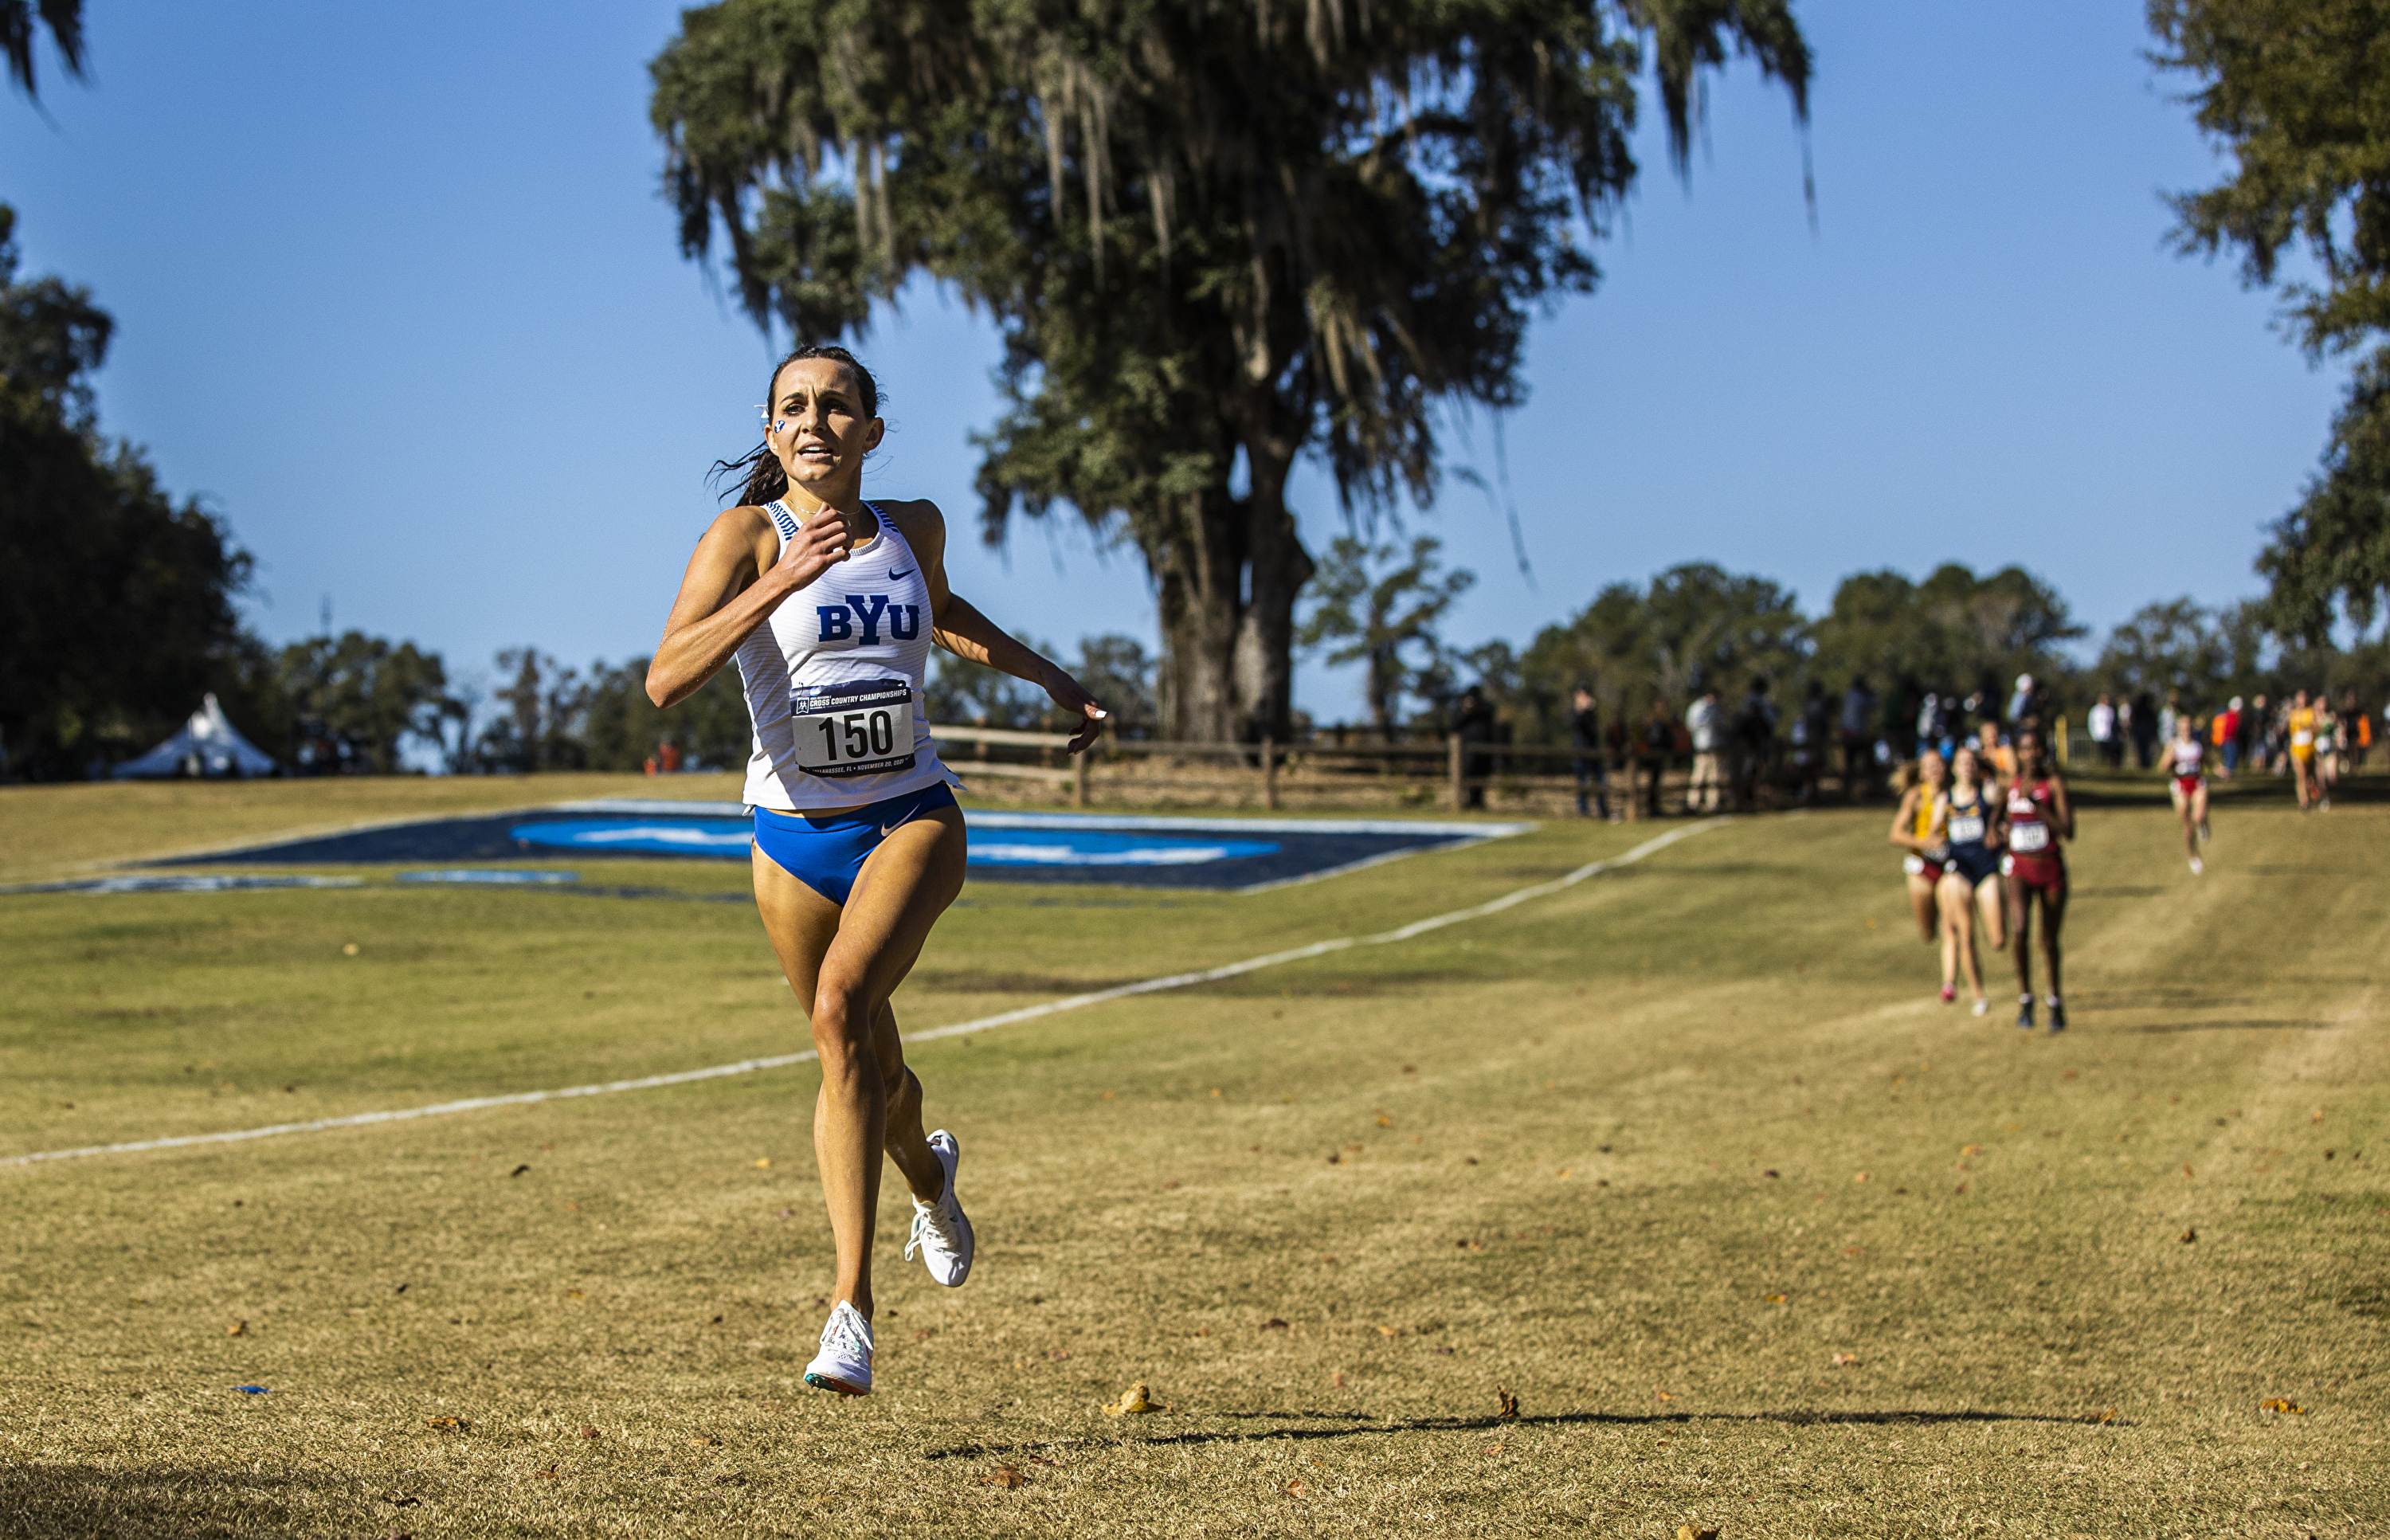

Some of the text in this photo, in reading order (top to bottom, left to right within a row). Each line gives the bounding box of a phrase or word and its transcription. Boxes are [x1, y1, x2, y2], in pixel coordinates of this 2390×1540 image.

[817, 594, 920, 645] BYU
[831, 696, 859, 705] COUNTRY
[860, 689, 907, 702] CHAMPIONSHIPS
[819, 710, 893, 761] 150
